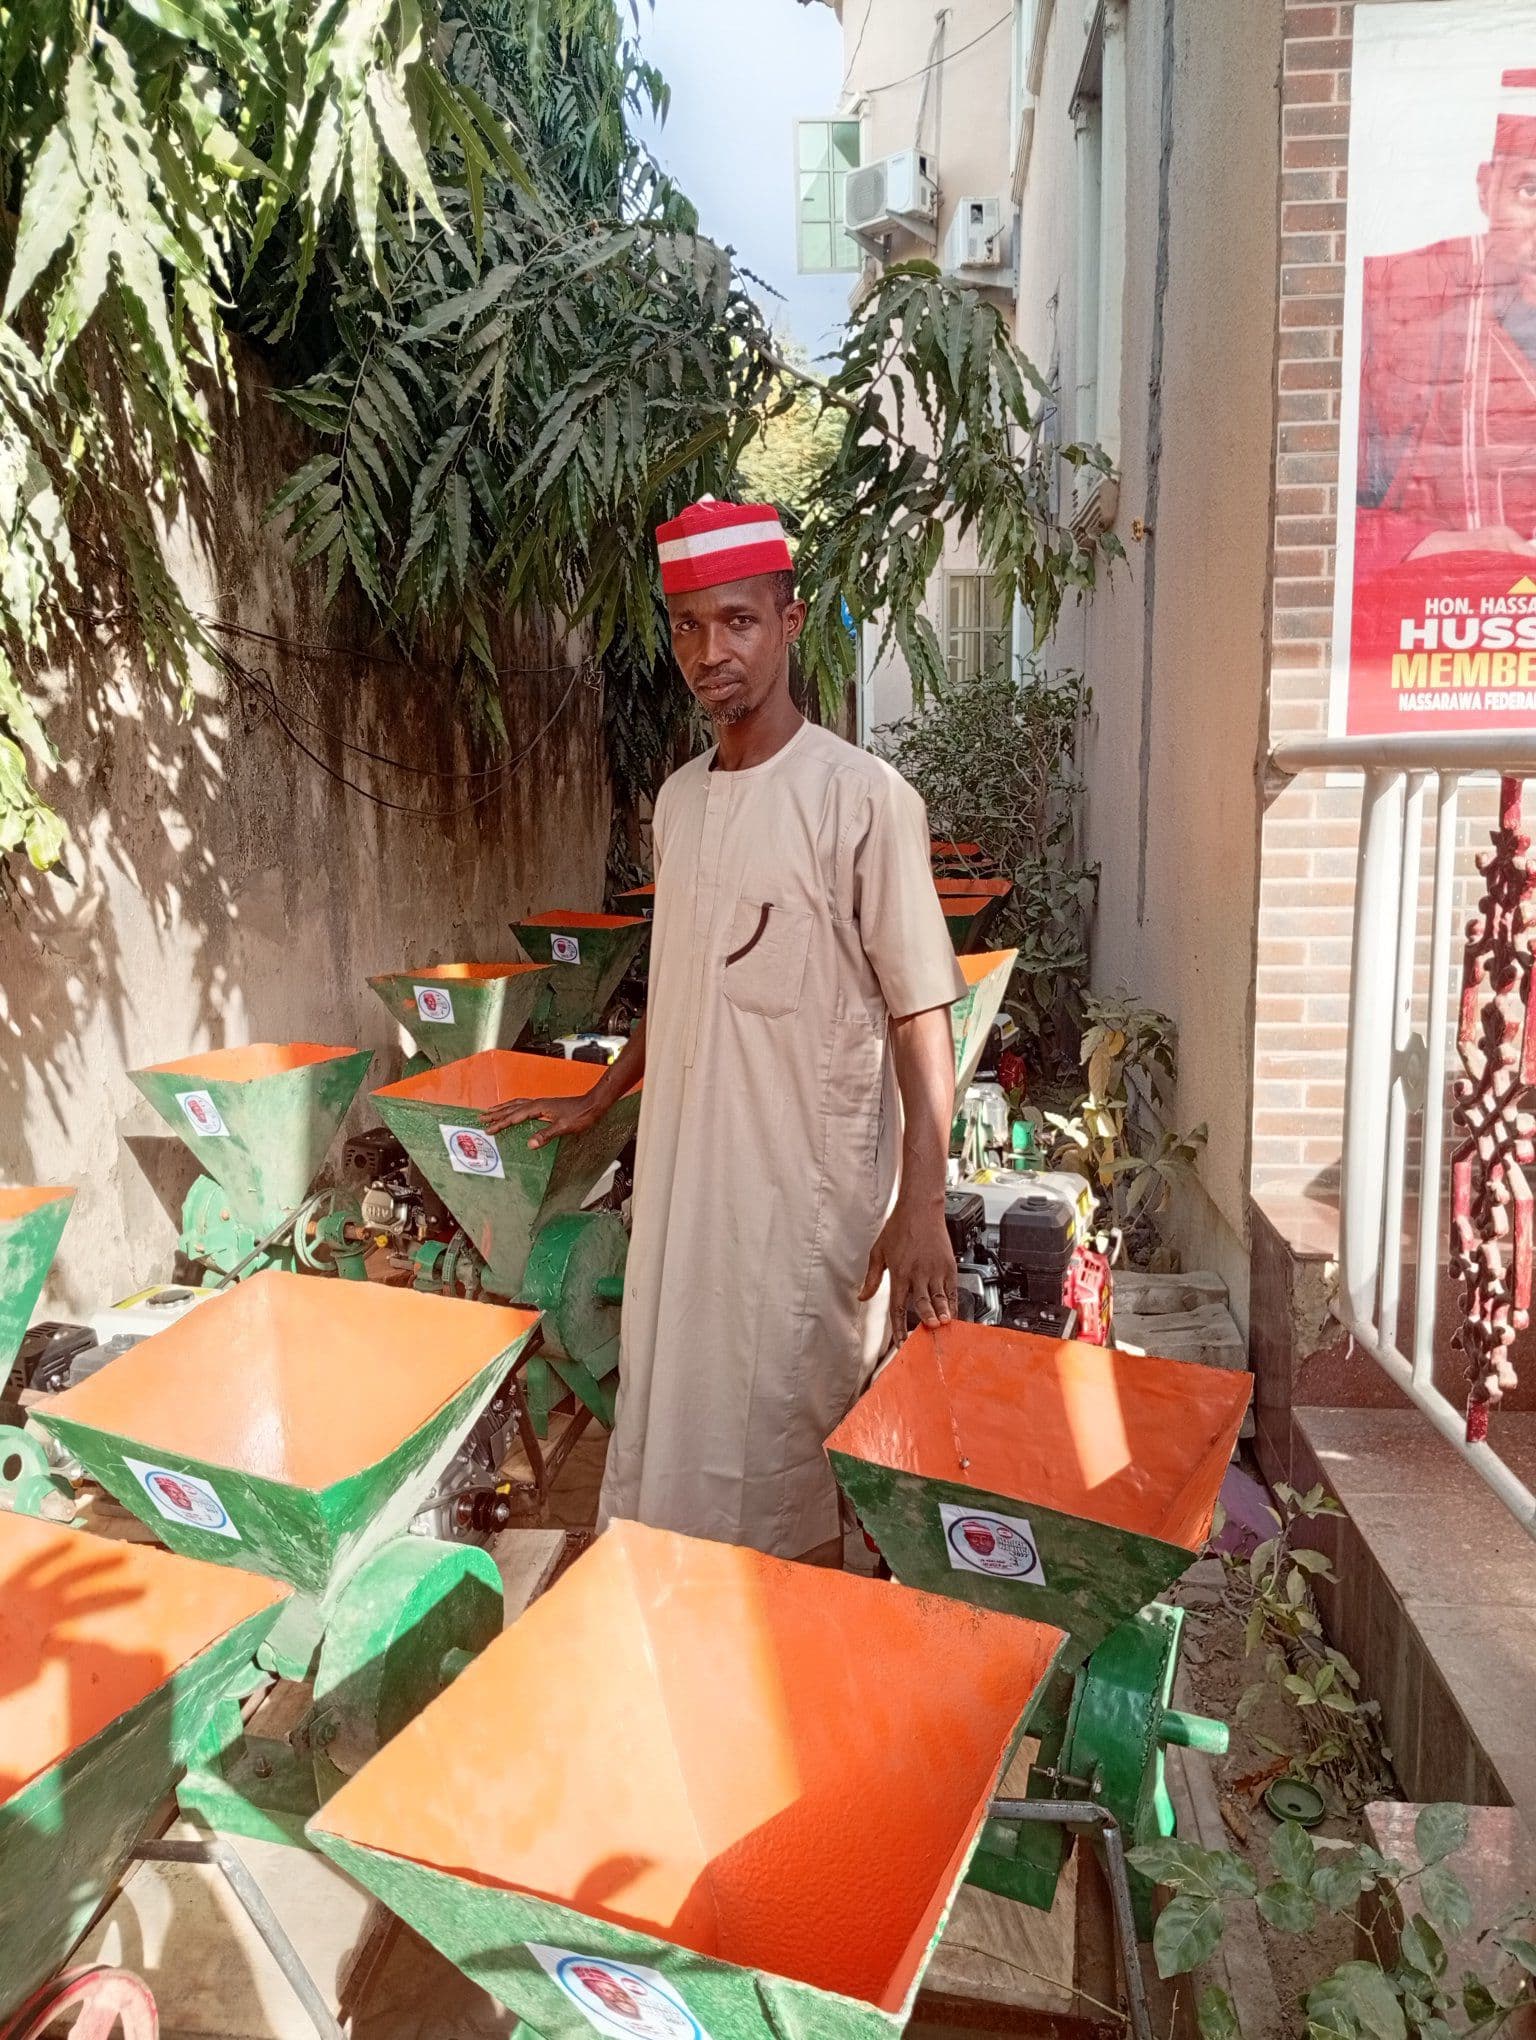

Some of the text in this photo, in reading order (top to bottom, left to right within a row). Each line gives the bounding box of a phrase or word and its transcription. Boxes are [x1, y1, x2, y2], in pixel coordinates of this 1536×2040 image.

[1425, 596, 1536, 616] HON. HASSA
[1400, 616, 1536, 649] HUSS
[1391, 651, 1536, 688] MEMBE
[1399, 691, 1482, 712] NASSARAWA
